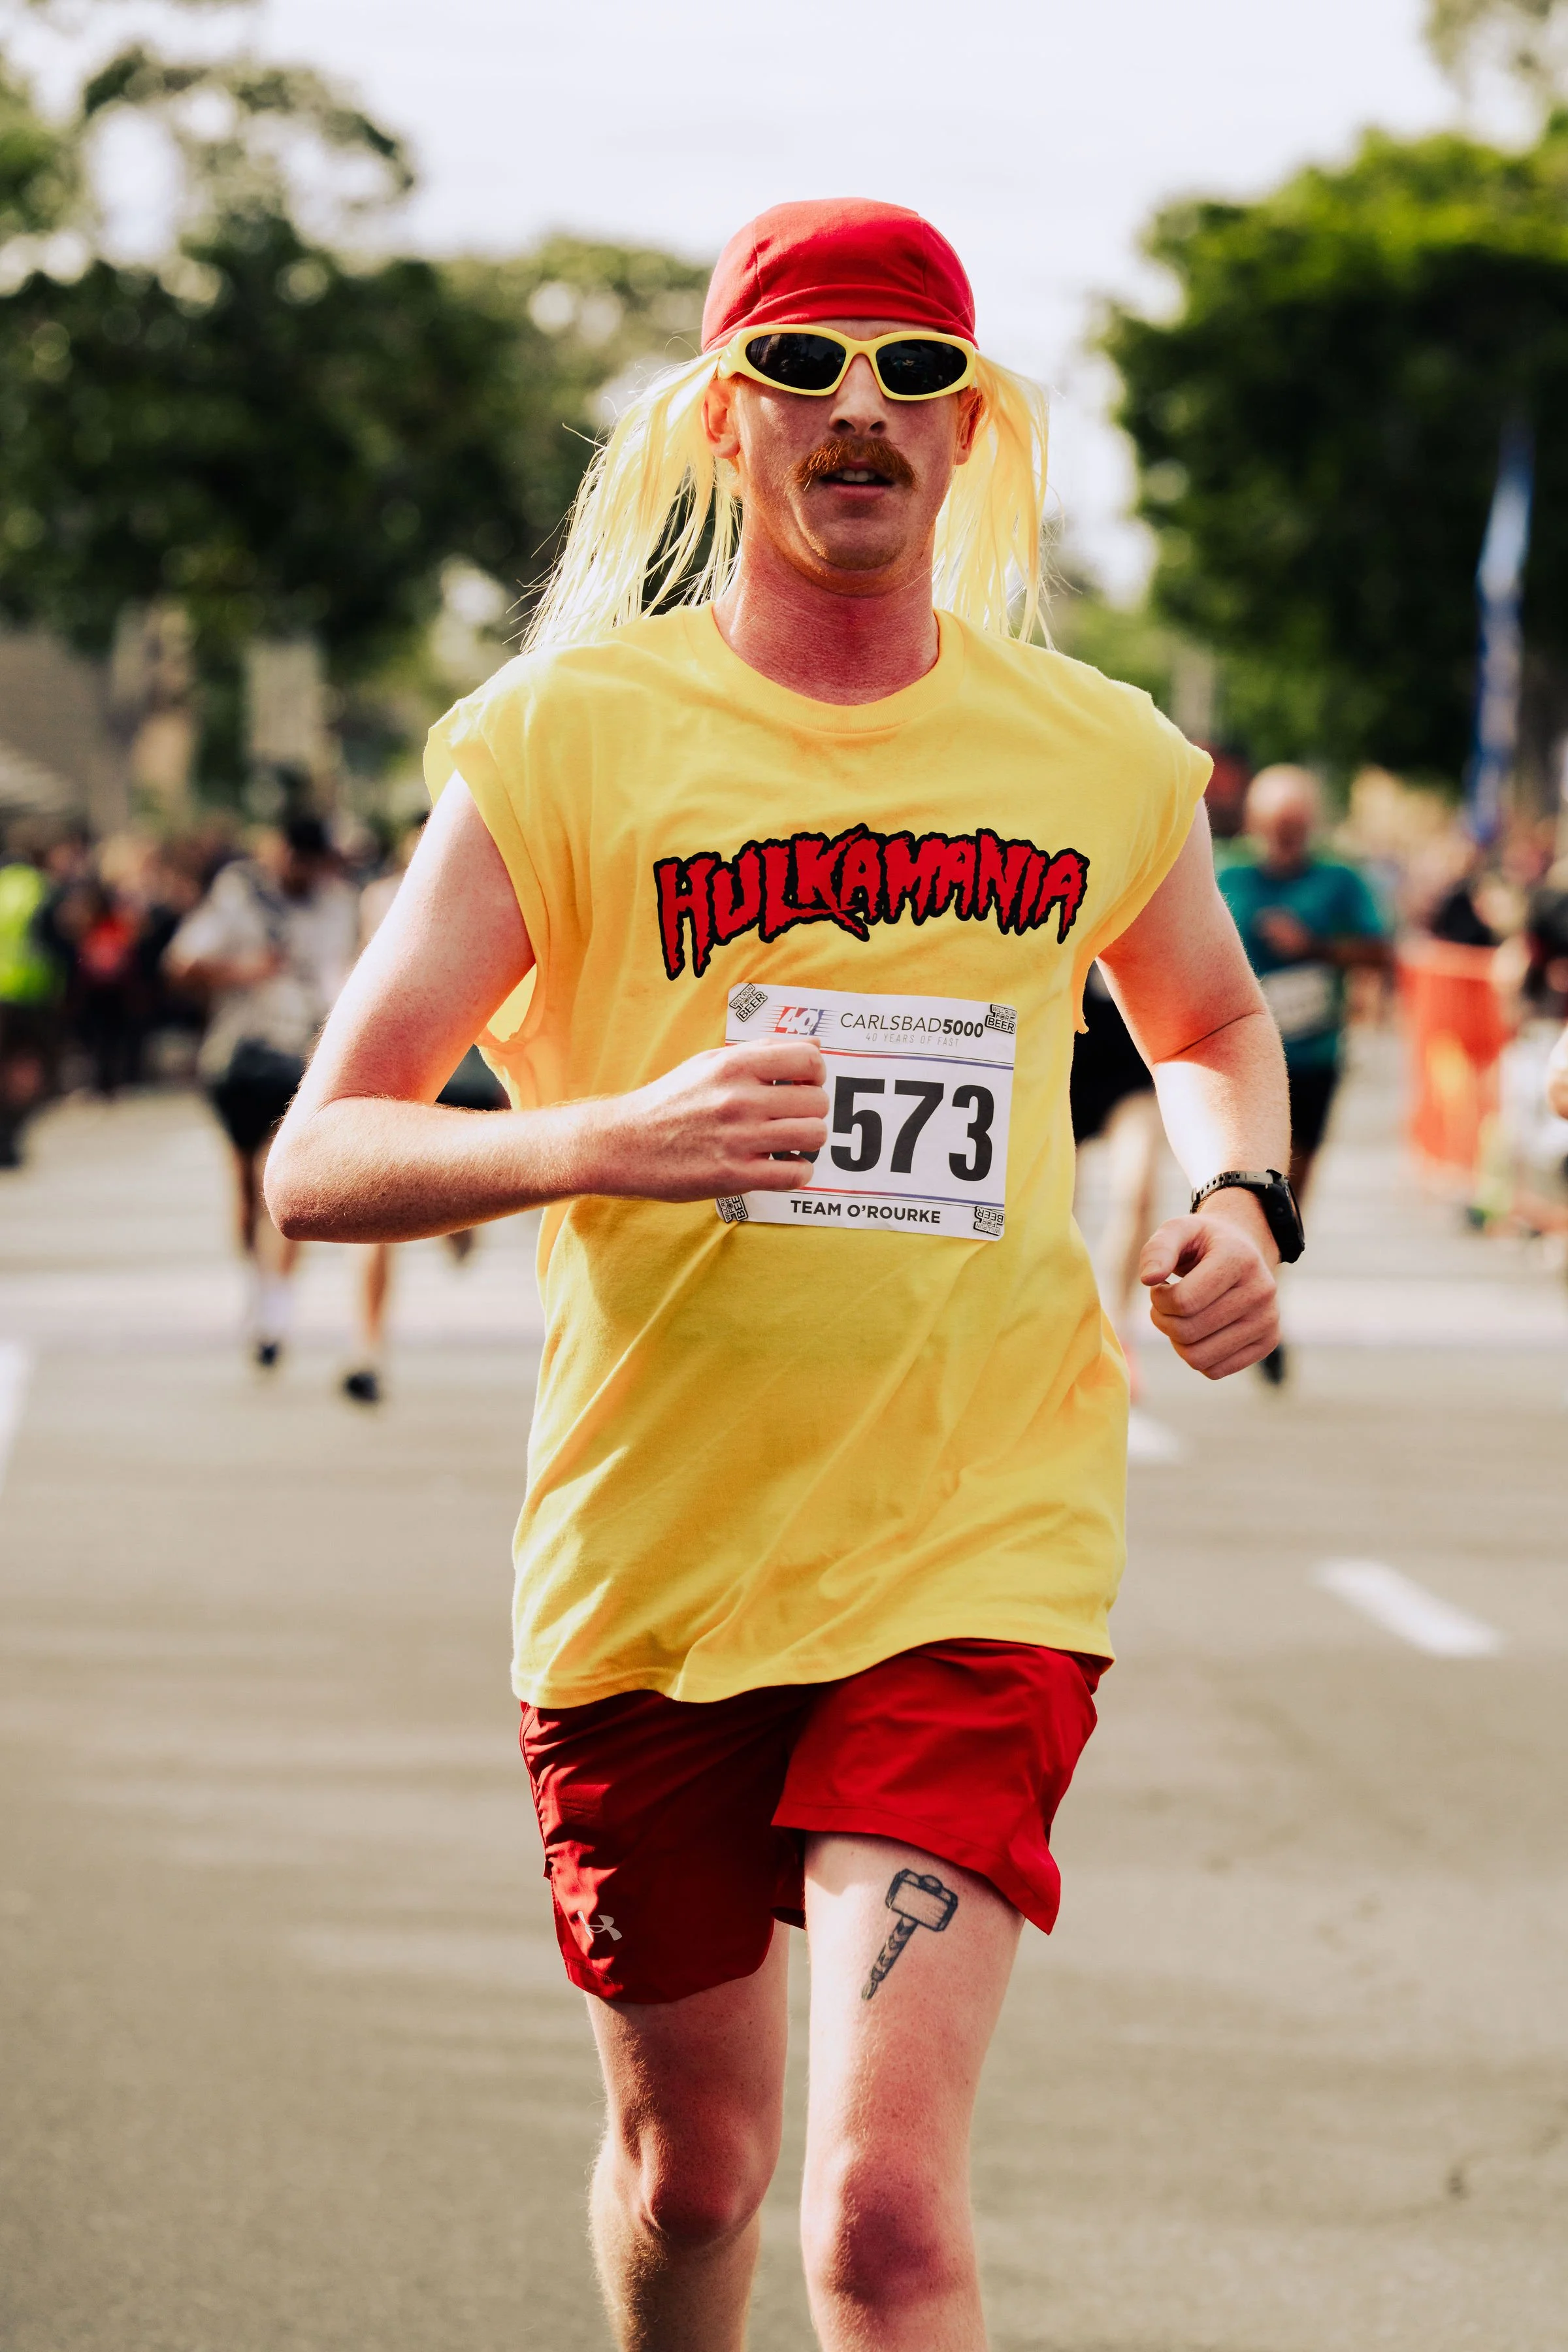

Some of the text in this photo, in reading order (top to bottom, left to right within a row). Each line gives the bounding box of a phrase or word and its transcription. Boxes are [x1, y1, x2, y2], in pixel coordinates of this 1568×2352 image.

[653, 823, 1089, 981] HULKAMANIA
[732, 986, 753, 1007] WILL RUN
[738, 993, 765, 1019] BEER
[740, 994, 753, 1007] FOR
[988, 1017, 1014, 1031] BEER
[866, 1033, 960, 1046] 40 YEARS OF FAST
[771, 1075, 994, 1181] 573
[731, 1195, 745, 1218] BEE
[791, 1200, 941, 1224] TEAM O'ROURKE
[977, 1209, 1004, 1223] BEER
